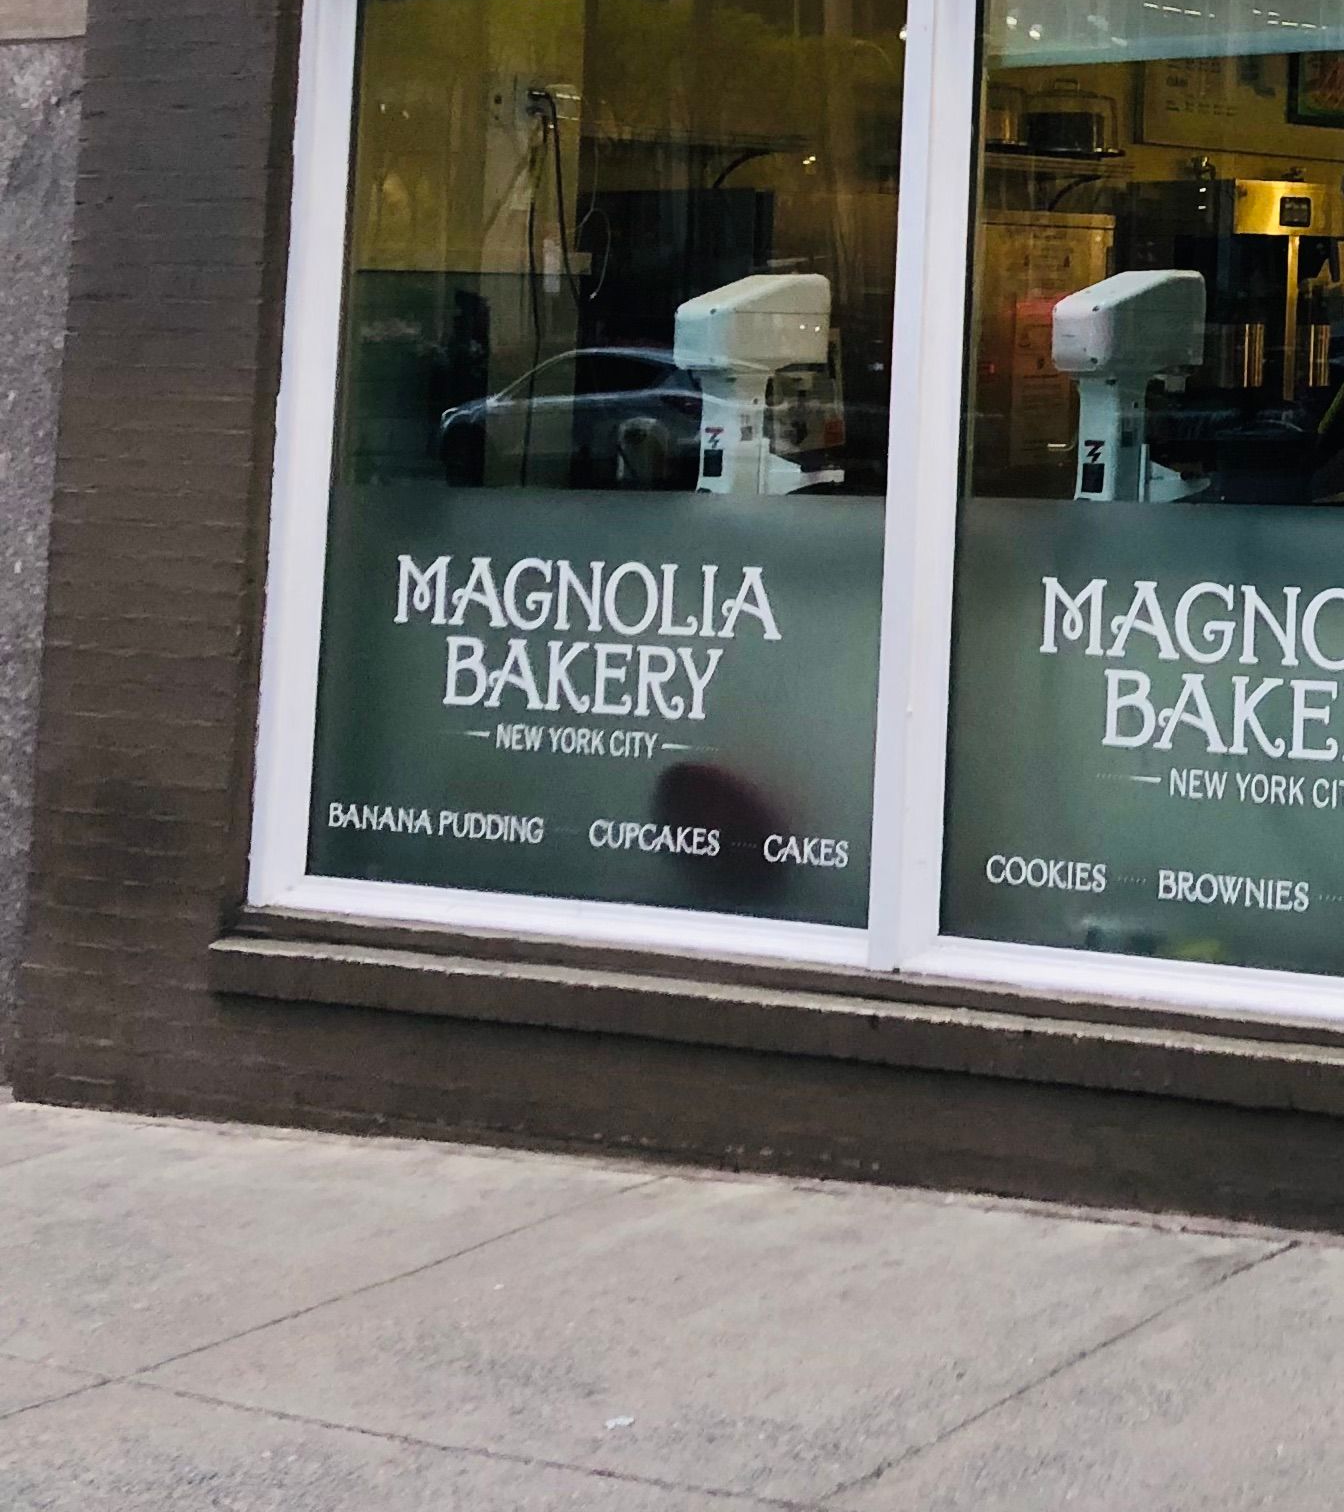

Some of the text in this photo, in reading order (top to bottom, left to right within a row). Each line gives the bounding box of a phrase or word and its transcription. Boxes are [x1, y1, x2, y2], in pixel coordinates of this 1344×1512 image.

[393, 553, 782, 641] MAGNOLIA
[443, 636, 723, 721] BAKERY
[496, 723, 659, 759] NEW YORK CITY
[1168, 767, 1228, 801] NEW
[1235, 772, 1306, 806] YORK
[328, 802, 850, 869] BANANA PUDDING CUPCAKES CAKES
[985, 853, 1108, 893] COOKIES
[1157, 868, 1310, 913] BROWNIES
